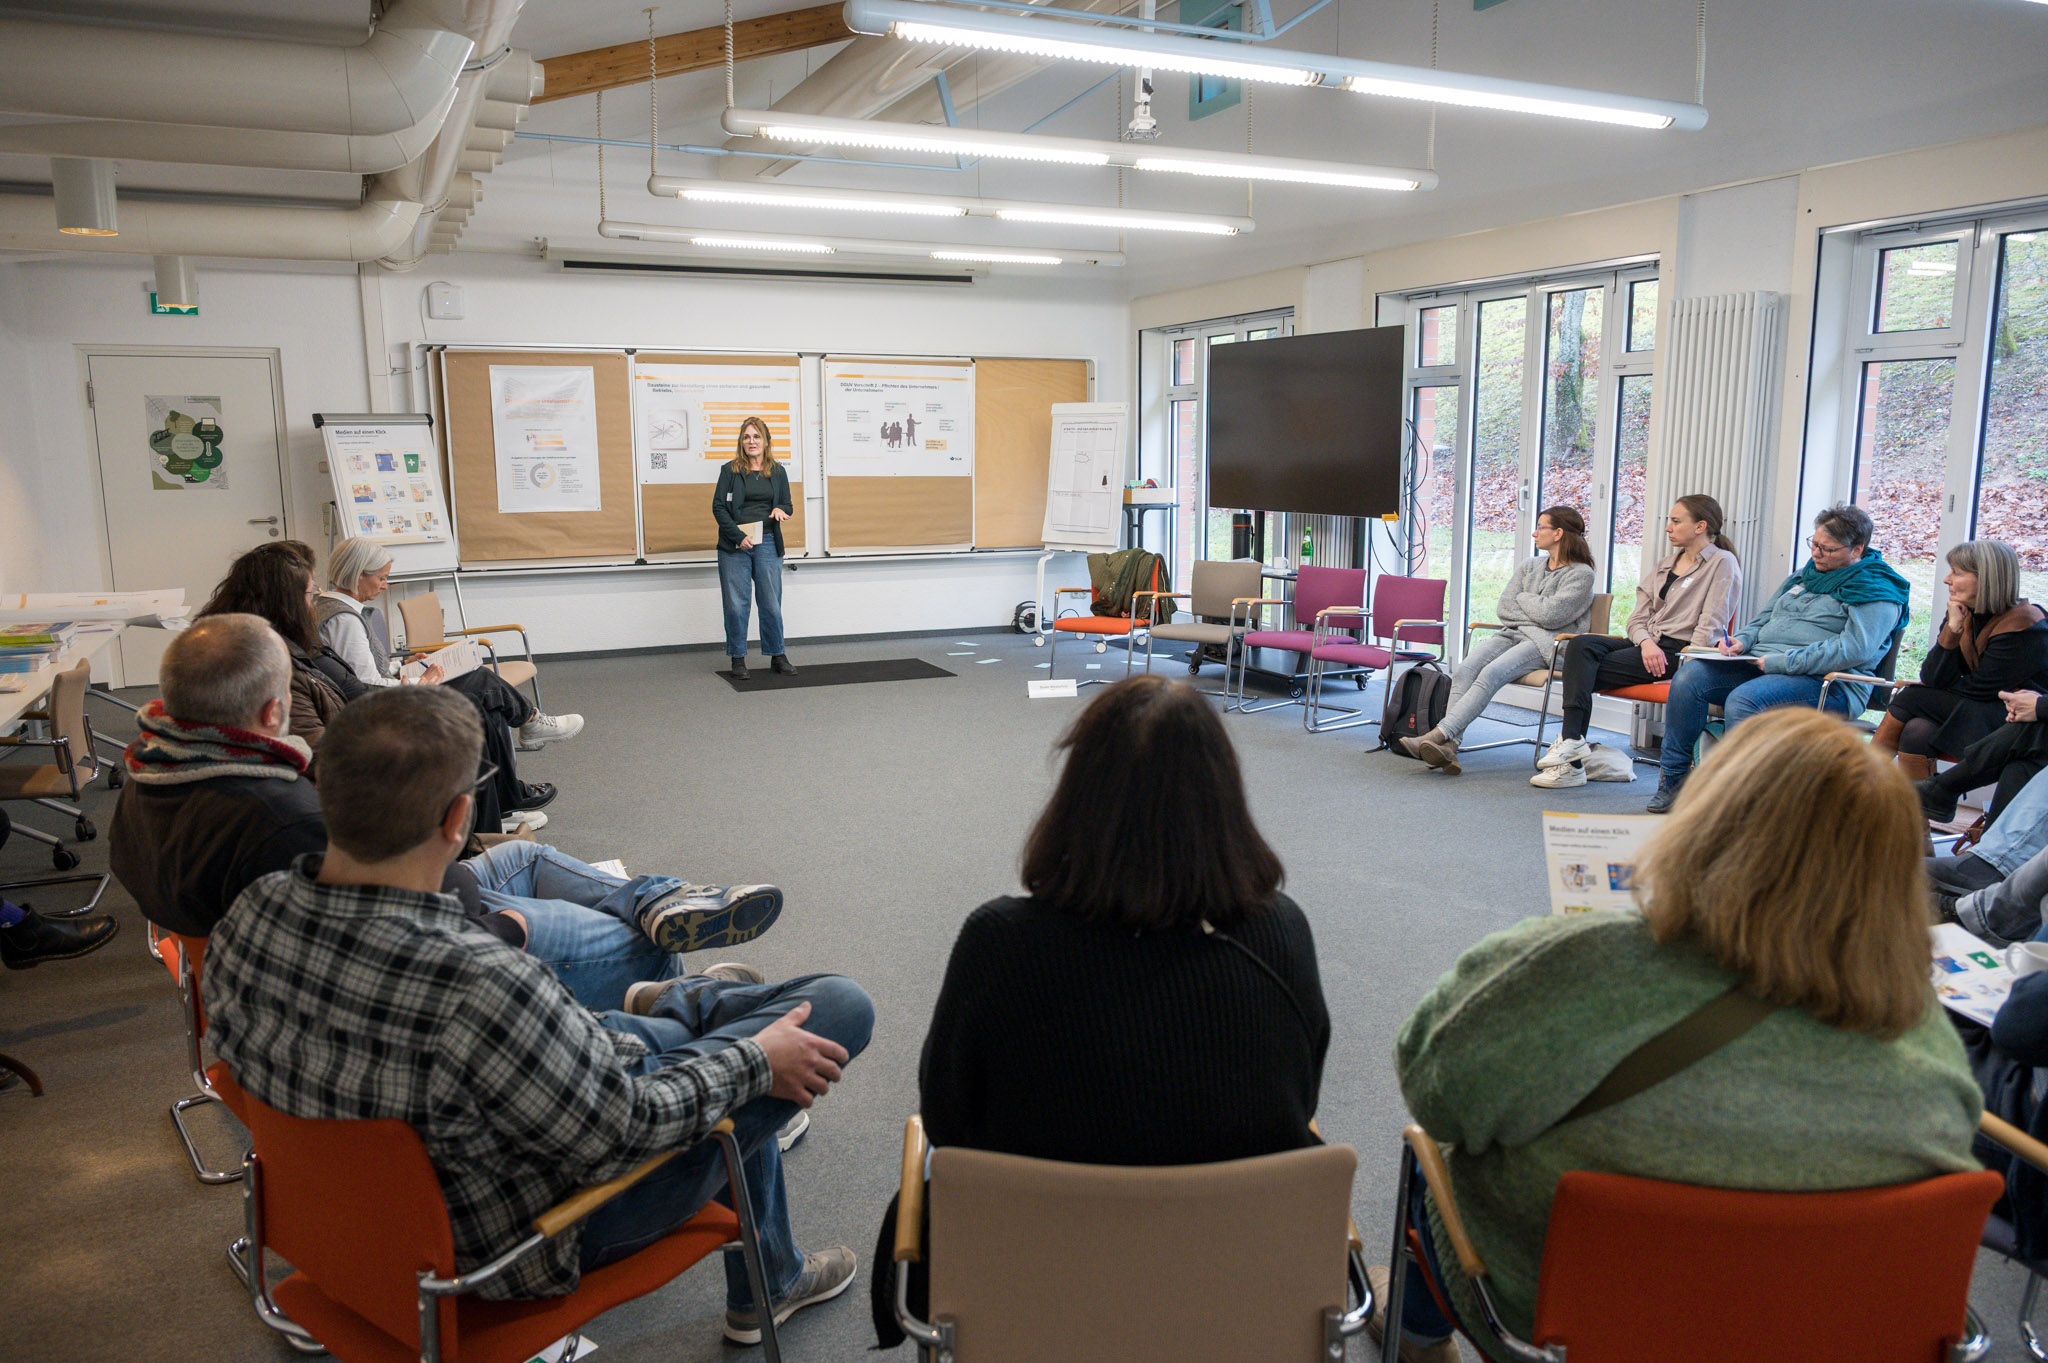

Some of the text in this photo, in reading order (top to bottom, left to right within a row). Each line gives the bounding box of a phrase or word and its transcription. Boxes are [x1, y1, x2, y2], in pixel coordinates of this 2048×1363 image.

[1549, 825, 1575, 833] Medien
[1578, 826, 1589, 834] auf
[1591, 827, 1610, 835] einen
[1612, 827, 1630, 836] Klick
